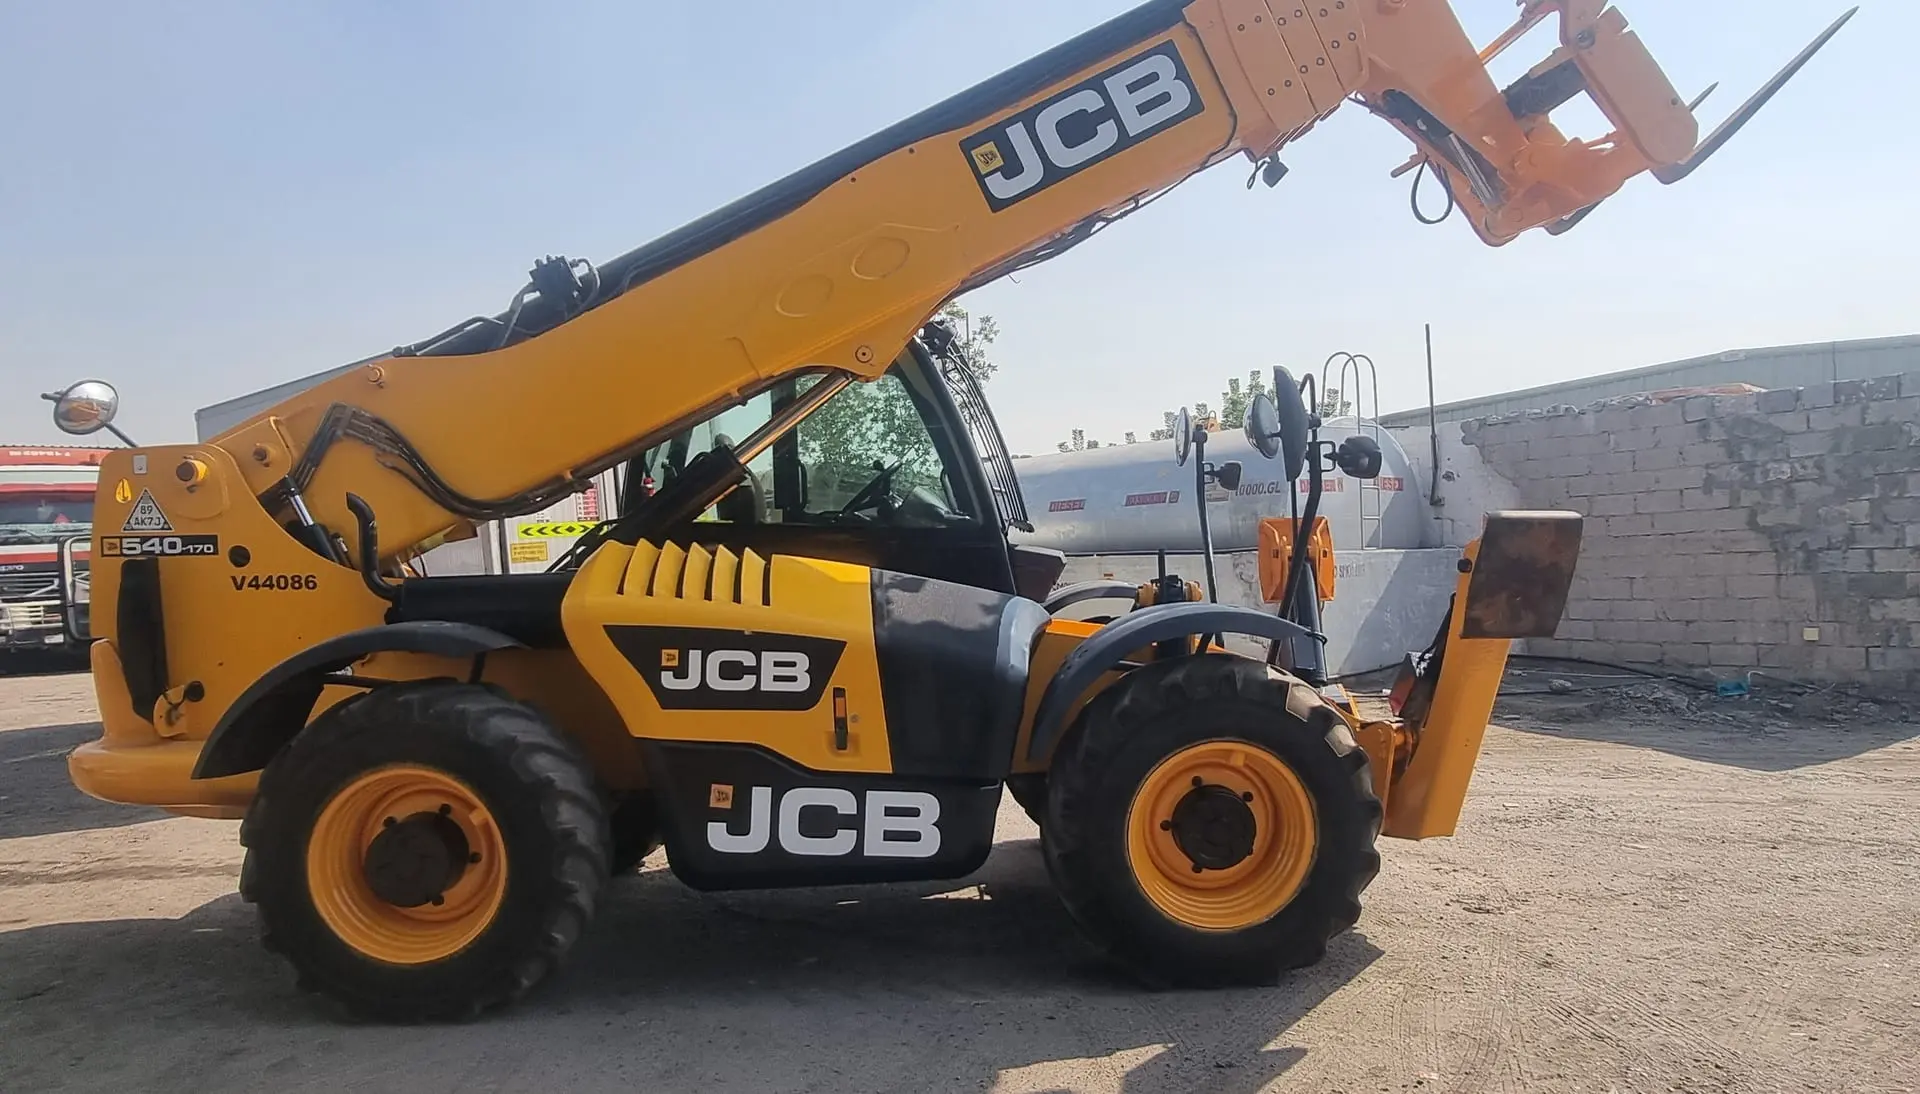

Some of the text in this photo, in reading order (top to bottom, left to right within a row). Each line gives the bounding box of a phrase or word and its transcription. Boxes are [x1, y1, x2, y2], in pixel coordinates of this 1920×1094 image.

[984, 54, 1191, 199] JCB
[140, 505, 153, 515] 89
[230, 574, 318, 590] V44086
[661, 650, 811, 692] JCB
[707, 786, 941, 857] JCB
